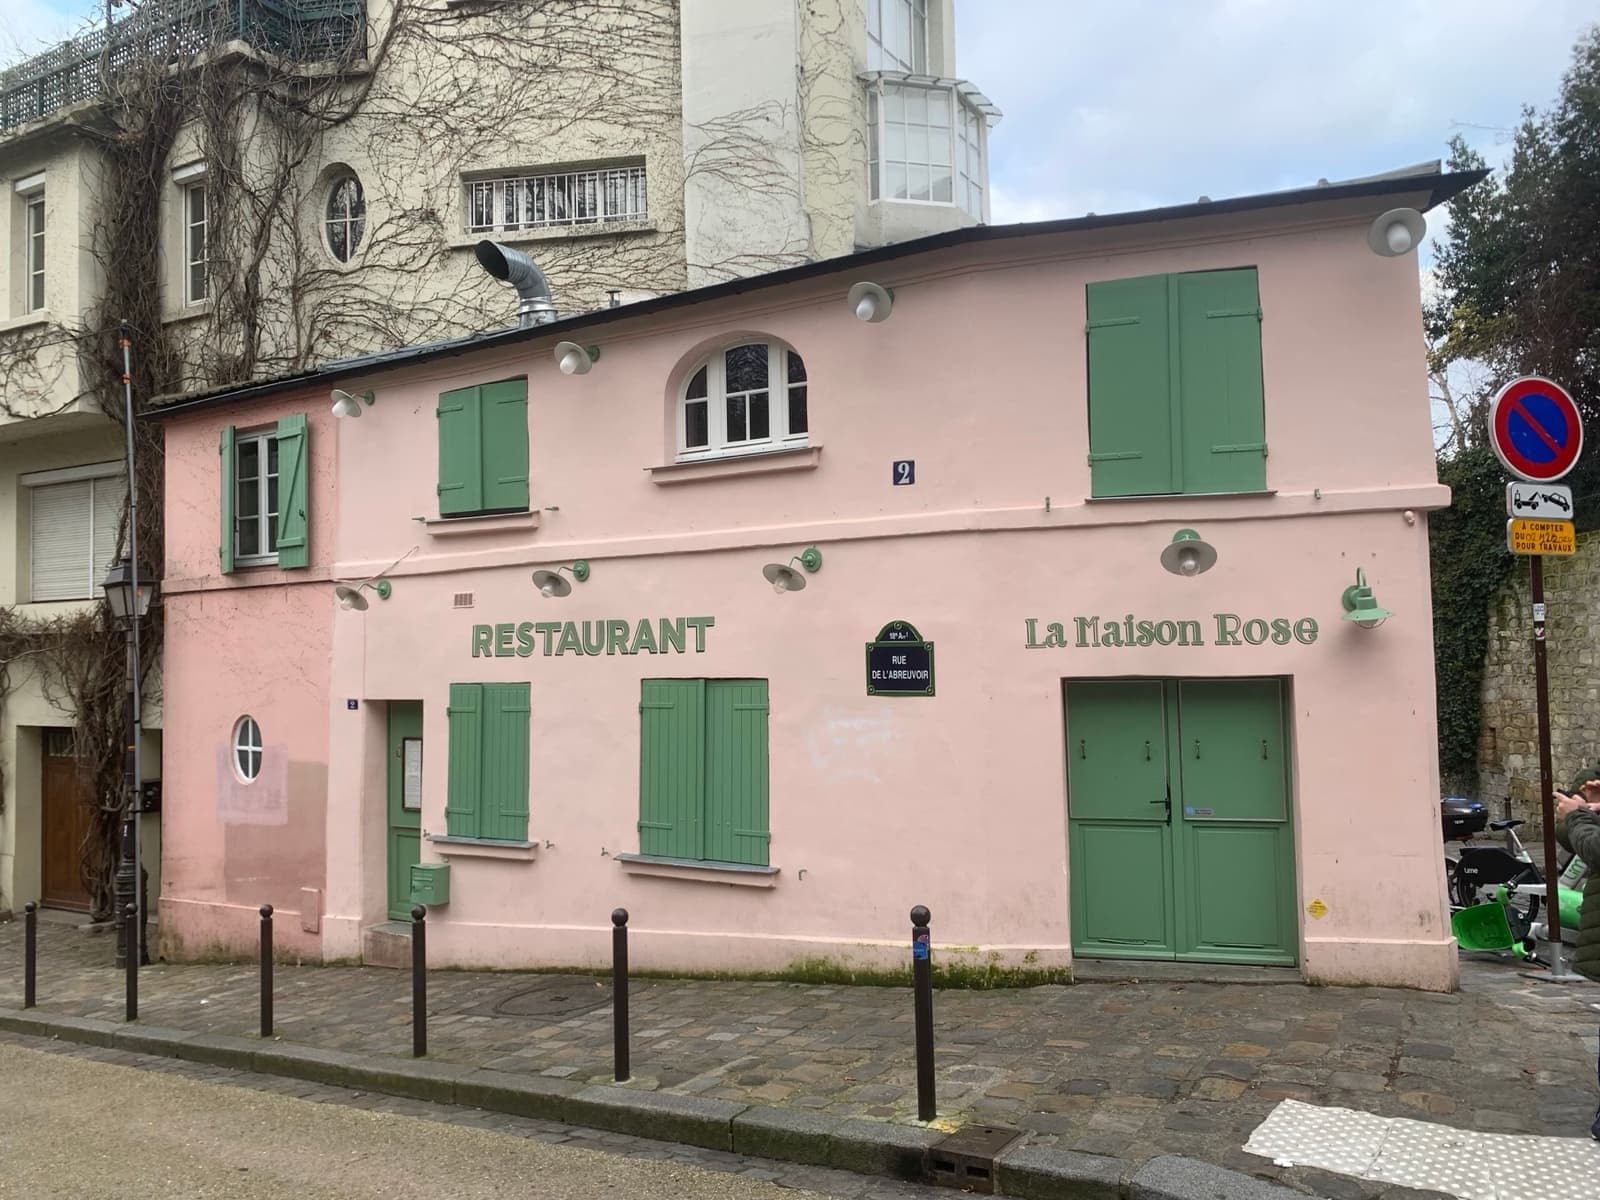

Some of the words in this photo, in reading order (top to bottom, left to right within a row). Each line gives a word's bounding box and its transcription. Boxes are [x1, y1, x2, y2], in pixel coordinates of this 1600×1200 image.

[897, 462, 910, 484] 2
[1529, 523, 1564, 532] COMPTER
[1515, 532, 1525, 540] DU
[1516, 542, 1536, 550] POUR
[1539, 543, 1573, 553] TRAVAUX
[1025, 617, 1068, 649] La
[1073, 614, 1205, 648] Maison
[1213, 613, 1319, 646] Rose
[472, 616, 715, 658] RESTAURANT
[892, 655, 907, 665] RUE
[871, 670, 882, 680] DE
[882, 669, 929, 680] L'ABREUVOIR
[1564, 858, 1585, 880] Lim
